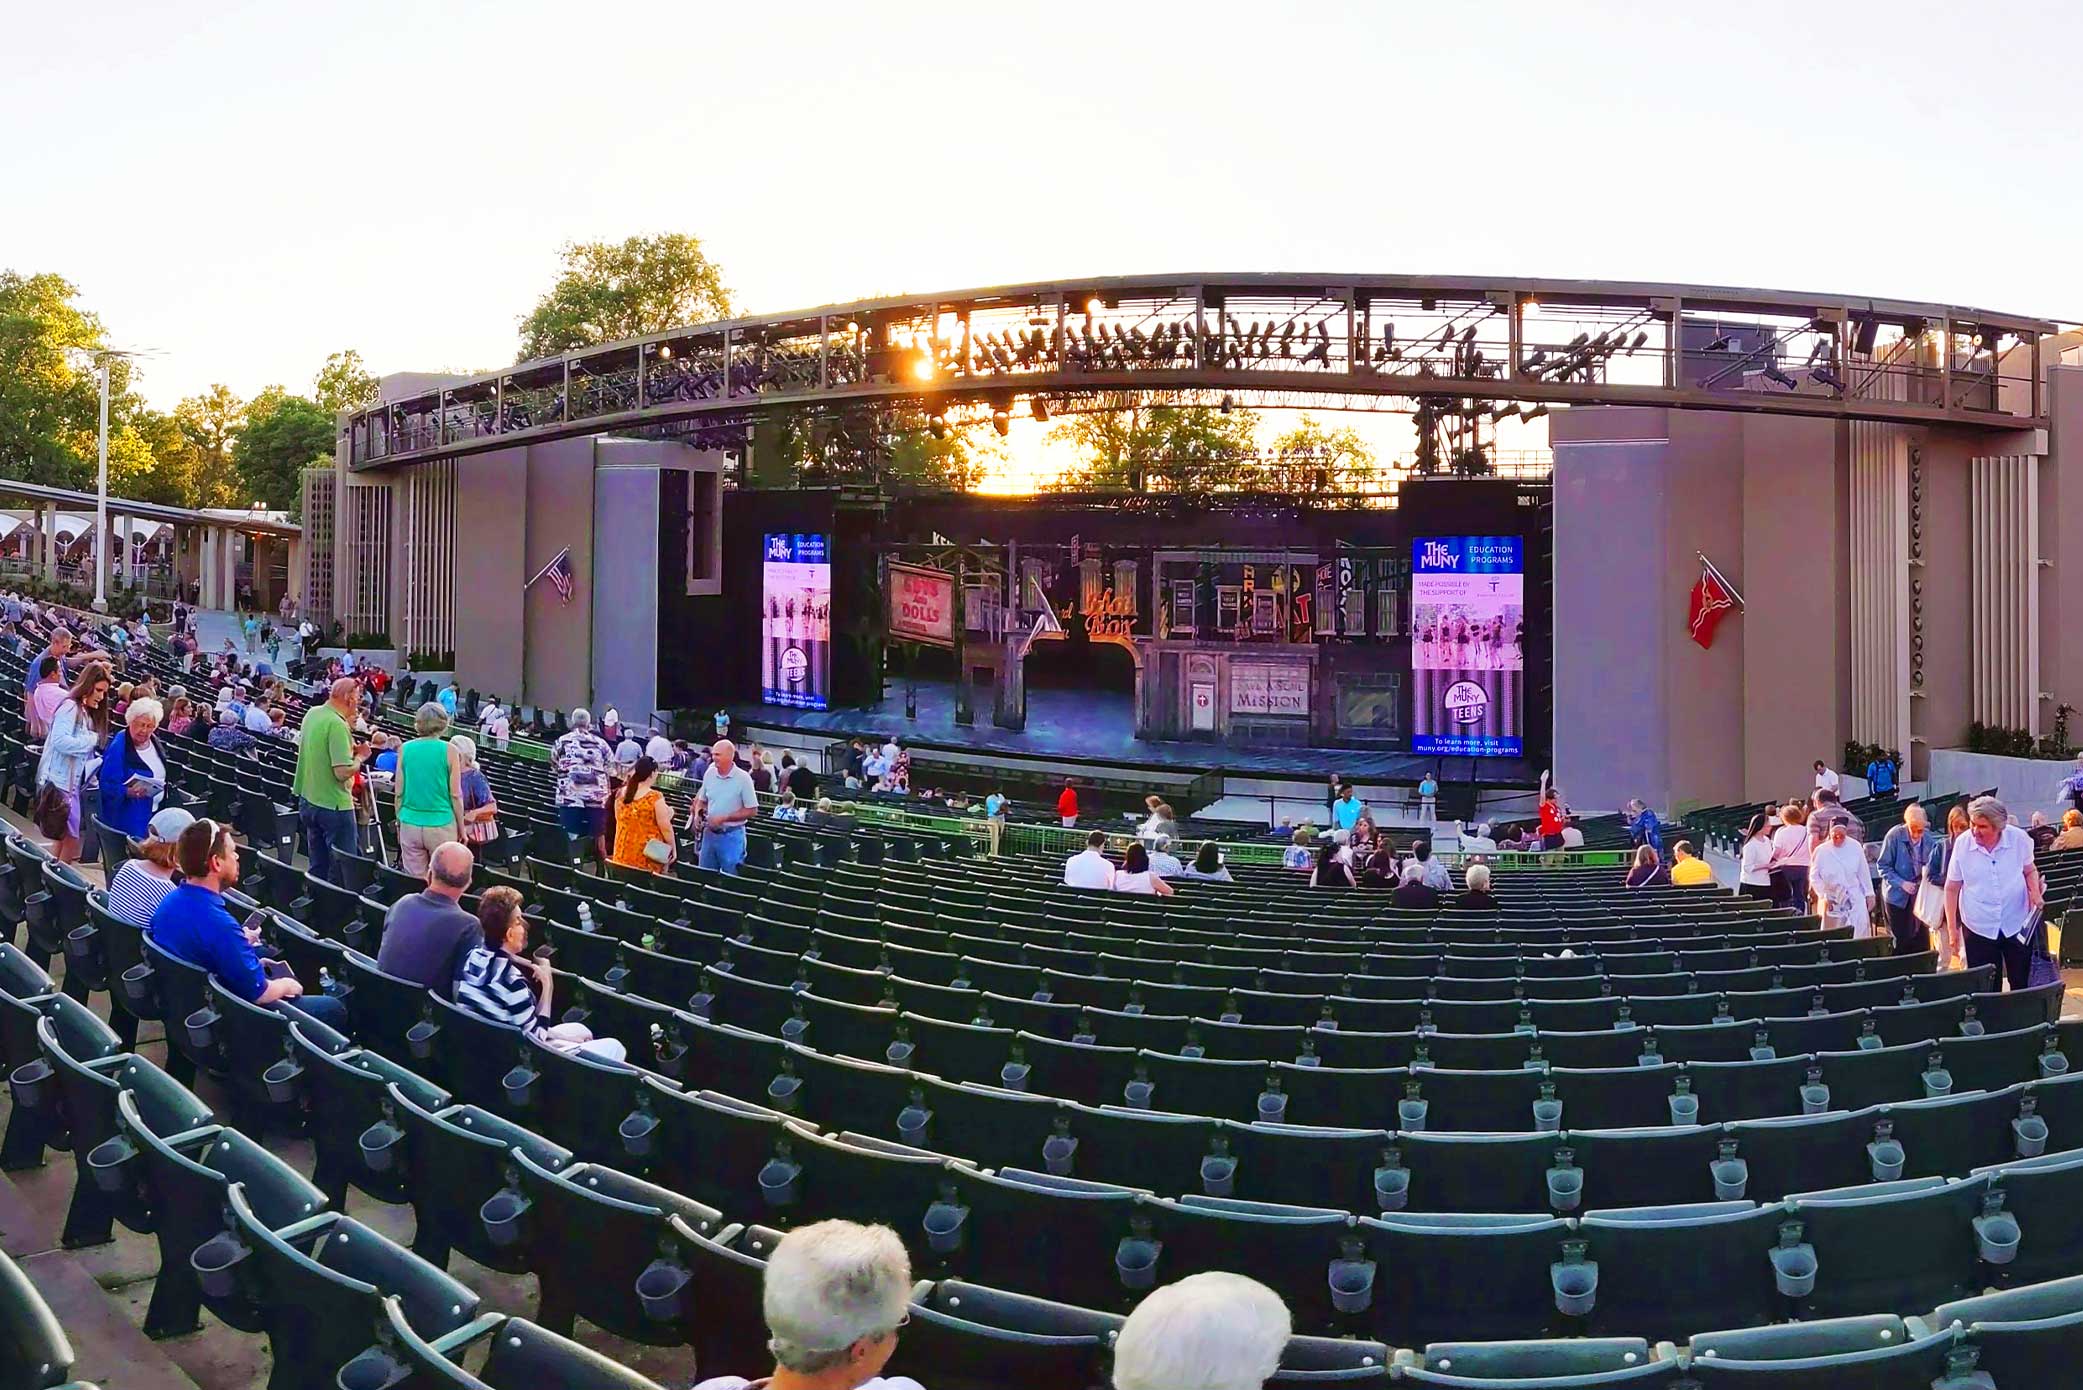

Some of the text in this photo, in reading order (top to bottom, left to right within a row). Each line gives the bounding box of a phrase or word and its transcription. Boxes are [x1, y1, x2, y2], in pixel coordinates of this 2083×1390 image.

[771, 537, 785, 548] THE
[1424, 541, 1448, 555] THE
[768, 547, 792, 559] MUNY
[1469, 546, 1513, 554] EDUCATION
[1421, 554, 1460, 568] MUNY
[1470, 556, 1514, 564] PROGRAMS
[902, 602, 939, 623] DOLLS
[1456, 685, 1472, 695] THE
[1237, 693, 1301, 707] MISSION
[1453, 694, 1480, 703] MUNY
[1453, 705, 1483, 719] TEENS
[1463, 739, 1483, 747] more,
